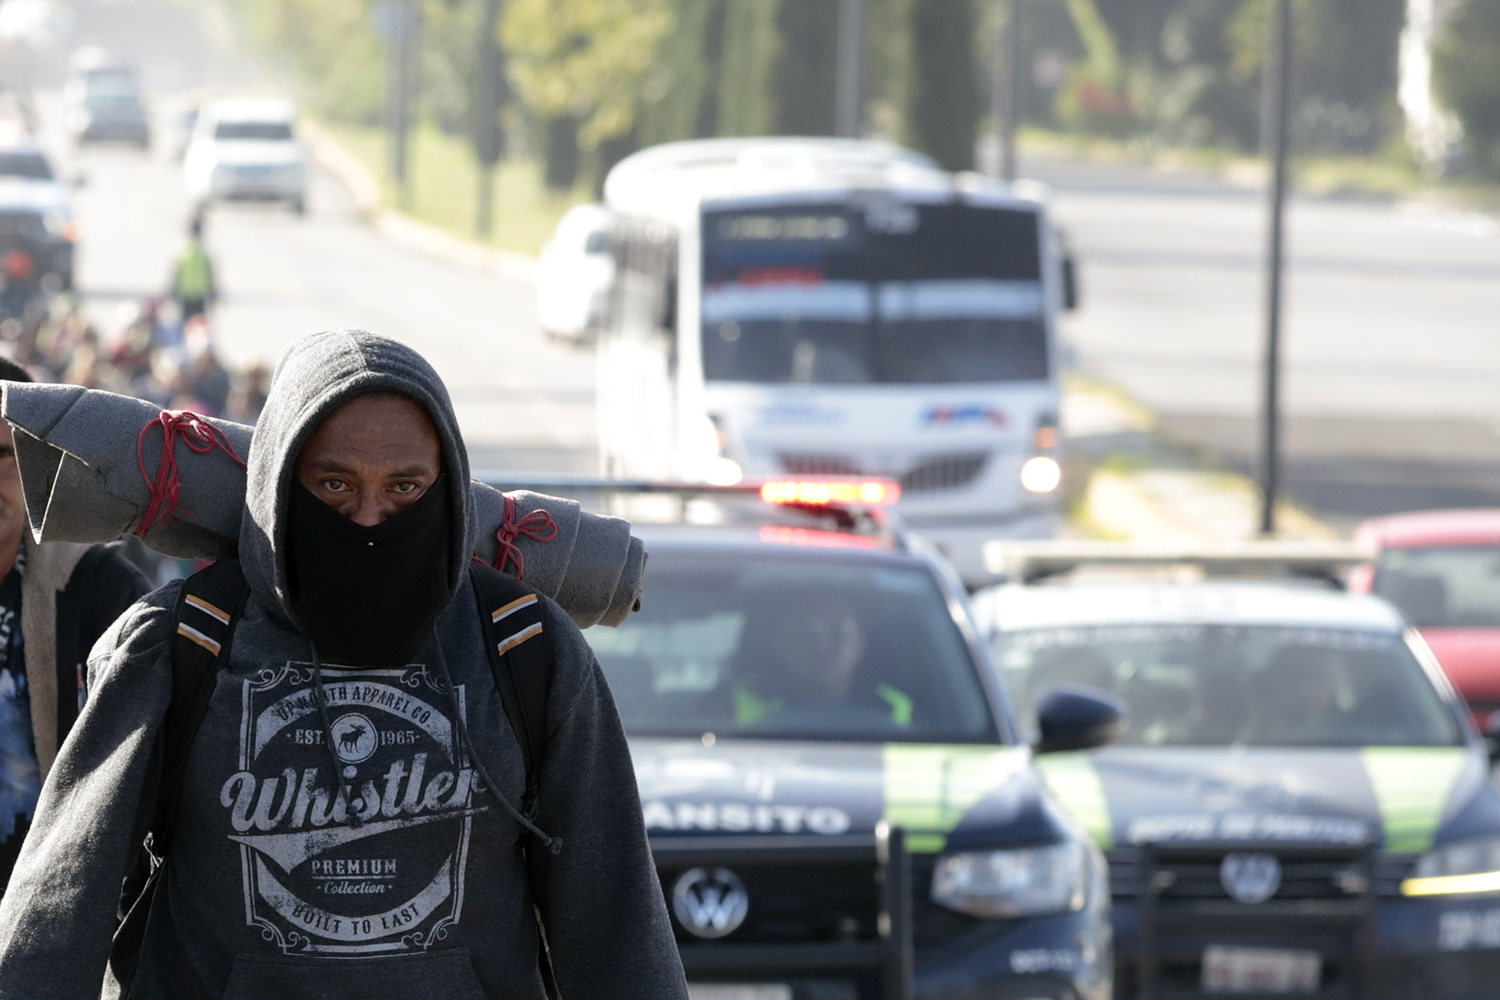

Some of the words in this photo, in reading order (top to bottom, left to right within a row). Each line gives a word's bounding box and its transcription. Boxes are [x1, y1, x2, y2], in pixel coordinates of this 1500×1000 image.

[352, 686, 409, 714] APPAREL
[219, 752, 490, 832] Whistler
[311, 858, 397, 875] PREMIUM
[324, 880, 386, 896] Collection
[291, 903, 342, 933] BUILT
[351, 920, 372, 935] TO
[381, 902, 420, 930] LAST
